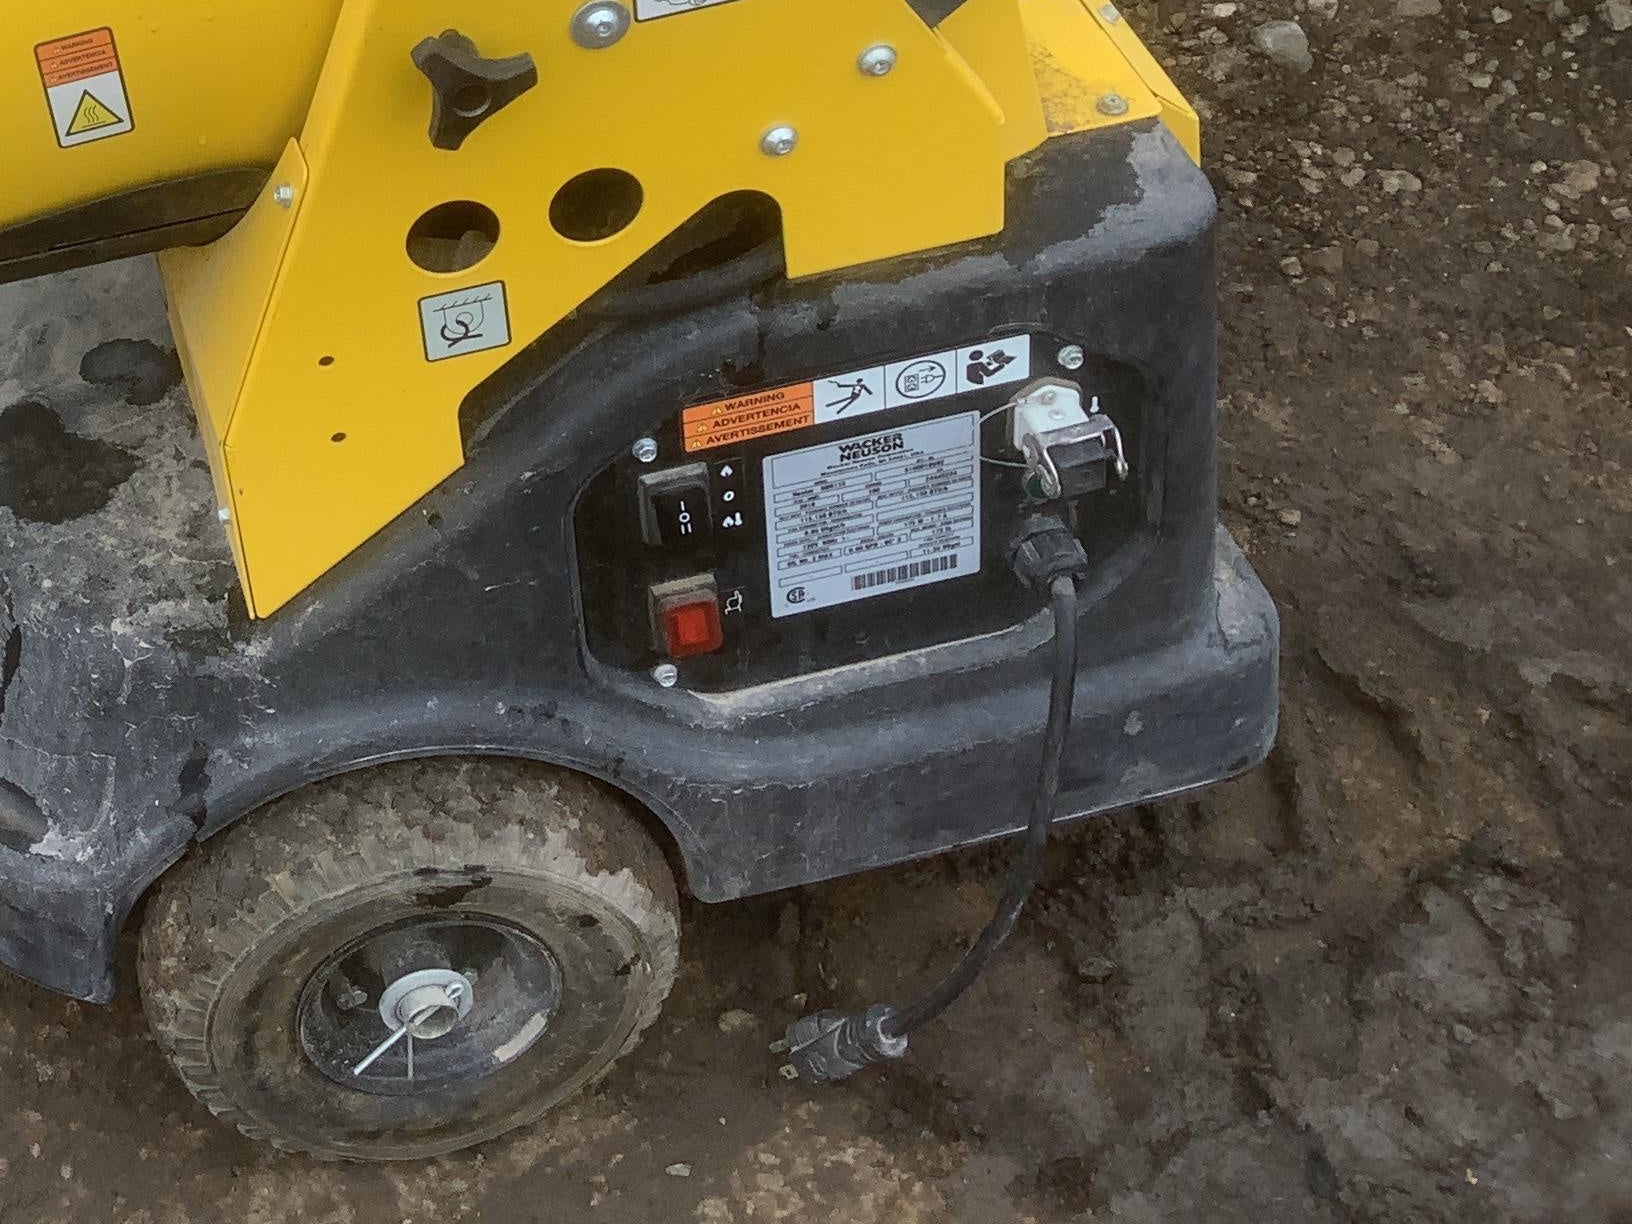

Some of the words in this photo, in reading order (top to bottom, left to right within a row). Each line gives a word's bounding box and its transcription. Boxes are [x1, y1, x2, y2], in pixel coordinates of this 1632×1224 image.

[61, 38, 94, 51] WARNING
[59, 49, 106, 66] ADVERTENCIA
[724, 392, 786, 411] WARNING
[712, 403, 801, 429] ADVERTENCIA
[706, 415, 811, 445] AVERTISSEMENT
[838, 432, 903, 454] WACKER
[839, 439, 904, 463] NEUSON
